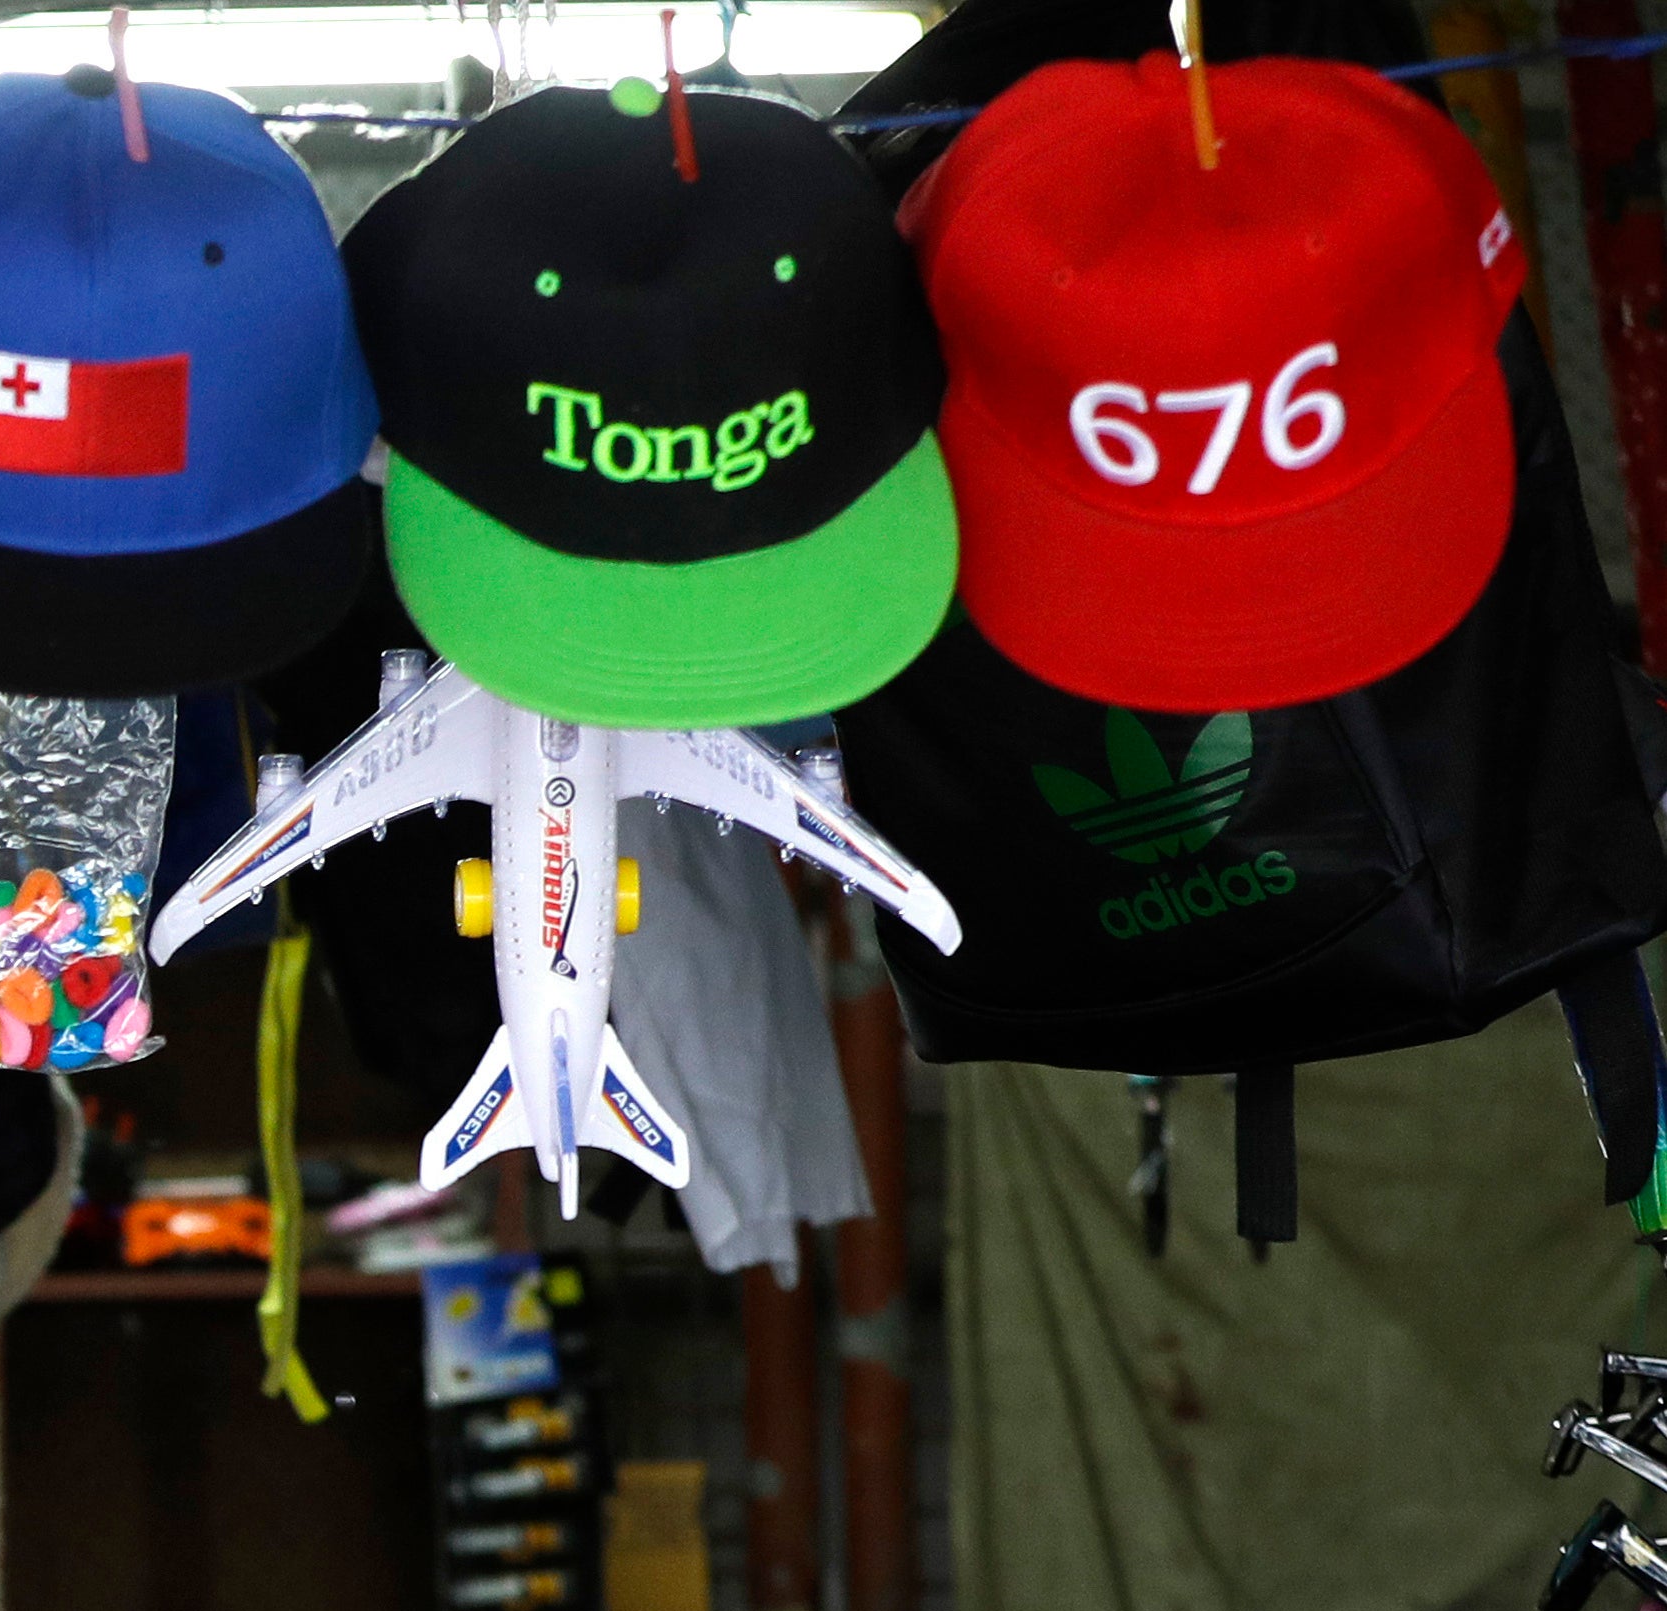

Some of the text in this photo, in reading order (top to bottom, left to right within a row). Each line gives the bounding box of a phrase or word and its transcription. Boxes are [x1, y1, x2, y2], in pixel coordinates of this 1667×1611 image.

[526, 380, 814, 493] Tonga
[1069, 340, 1346, 497] 676
[259, 818, 309, 861] AIRBUS
[538, 807, 565, 951] AIRBUS
[1099, 849, 1297, 942] adidas
[456, 1090, 502, 1150] A380
[611, 1091, 662, 1147] A380
